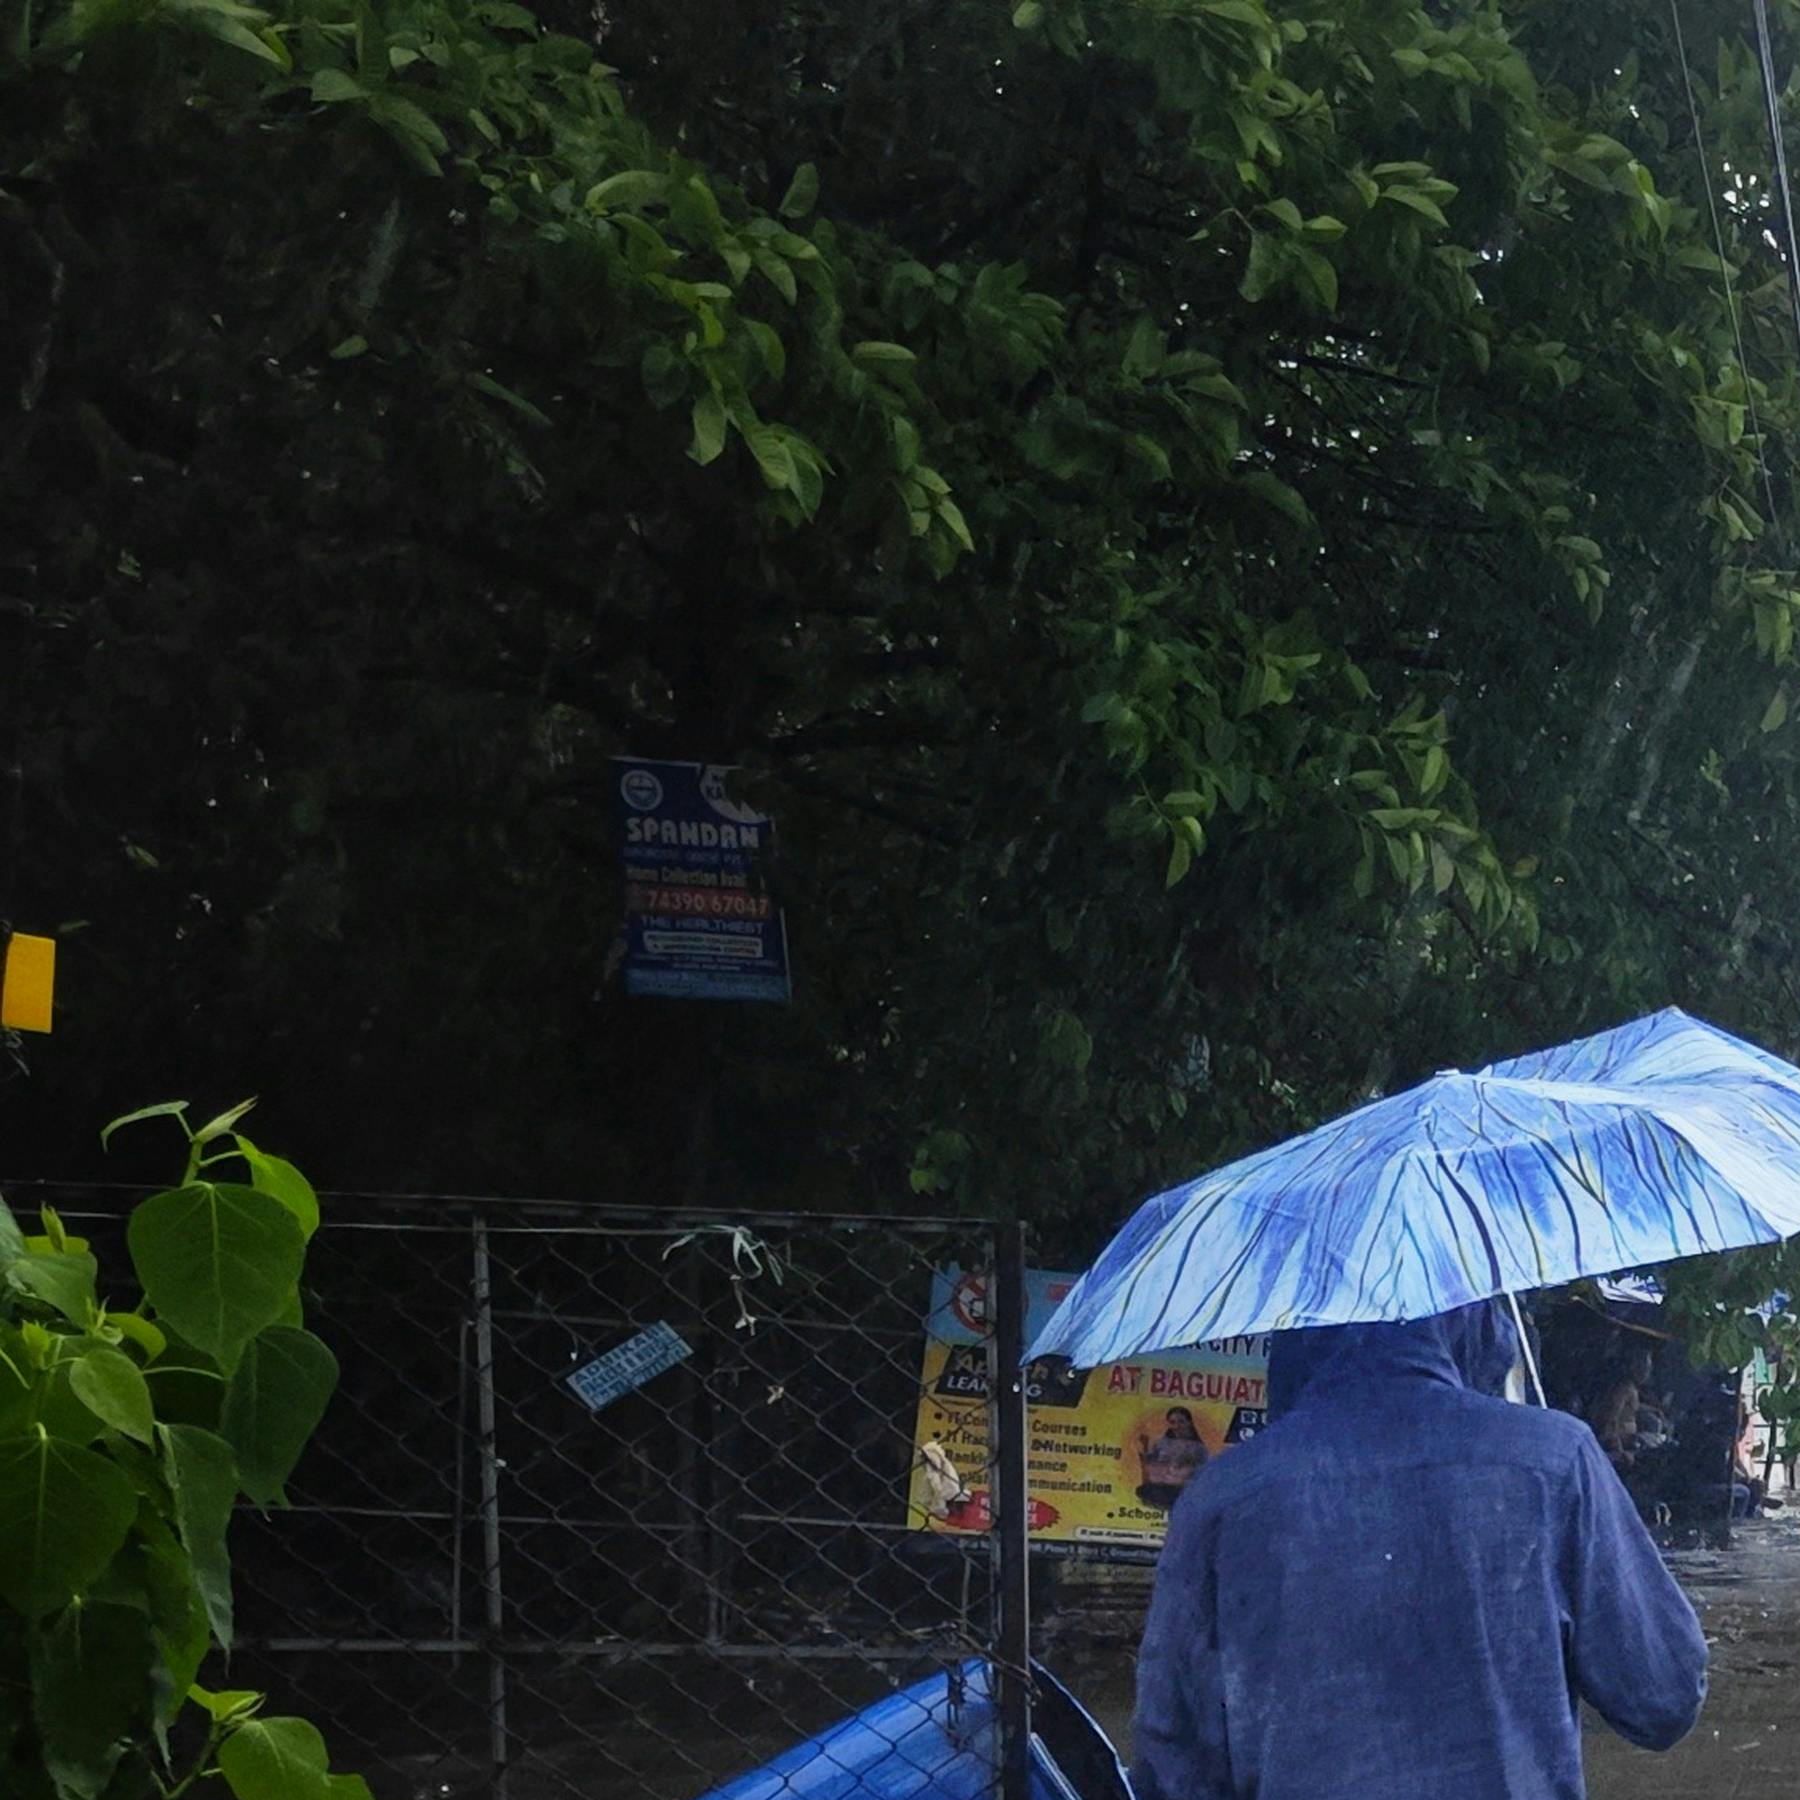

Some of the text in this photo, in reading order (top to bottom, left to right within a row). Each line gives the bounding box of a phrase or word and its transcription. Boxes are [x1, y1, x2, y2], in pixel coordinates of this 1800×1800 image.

[626, 816, 759, 849] SPANDAN
[647, 890, 769, 915] 74390 67047
[1107, 1365, 1265, 1405] AT BAGUIAT
[1031, 1419, 1087, 1437] Courses
[1043, 1440, 1122, 1460] Networking
[1118, 1506, 1164, 1520] School
